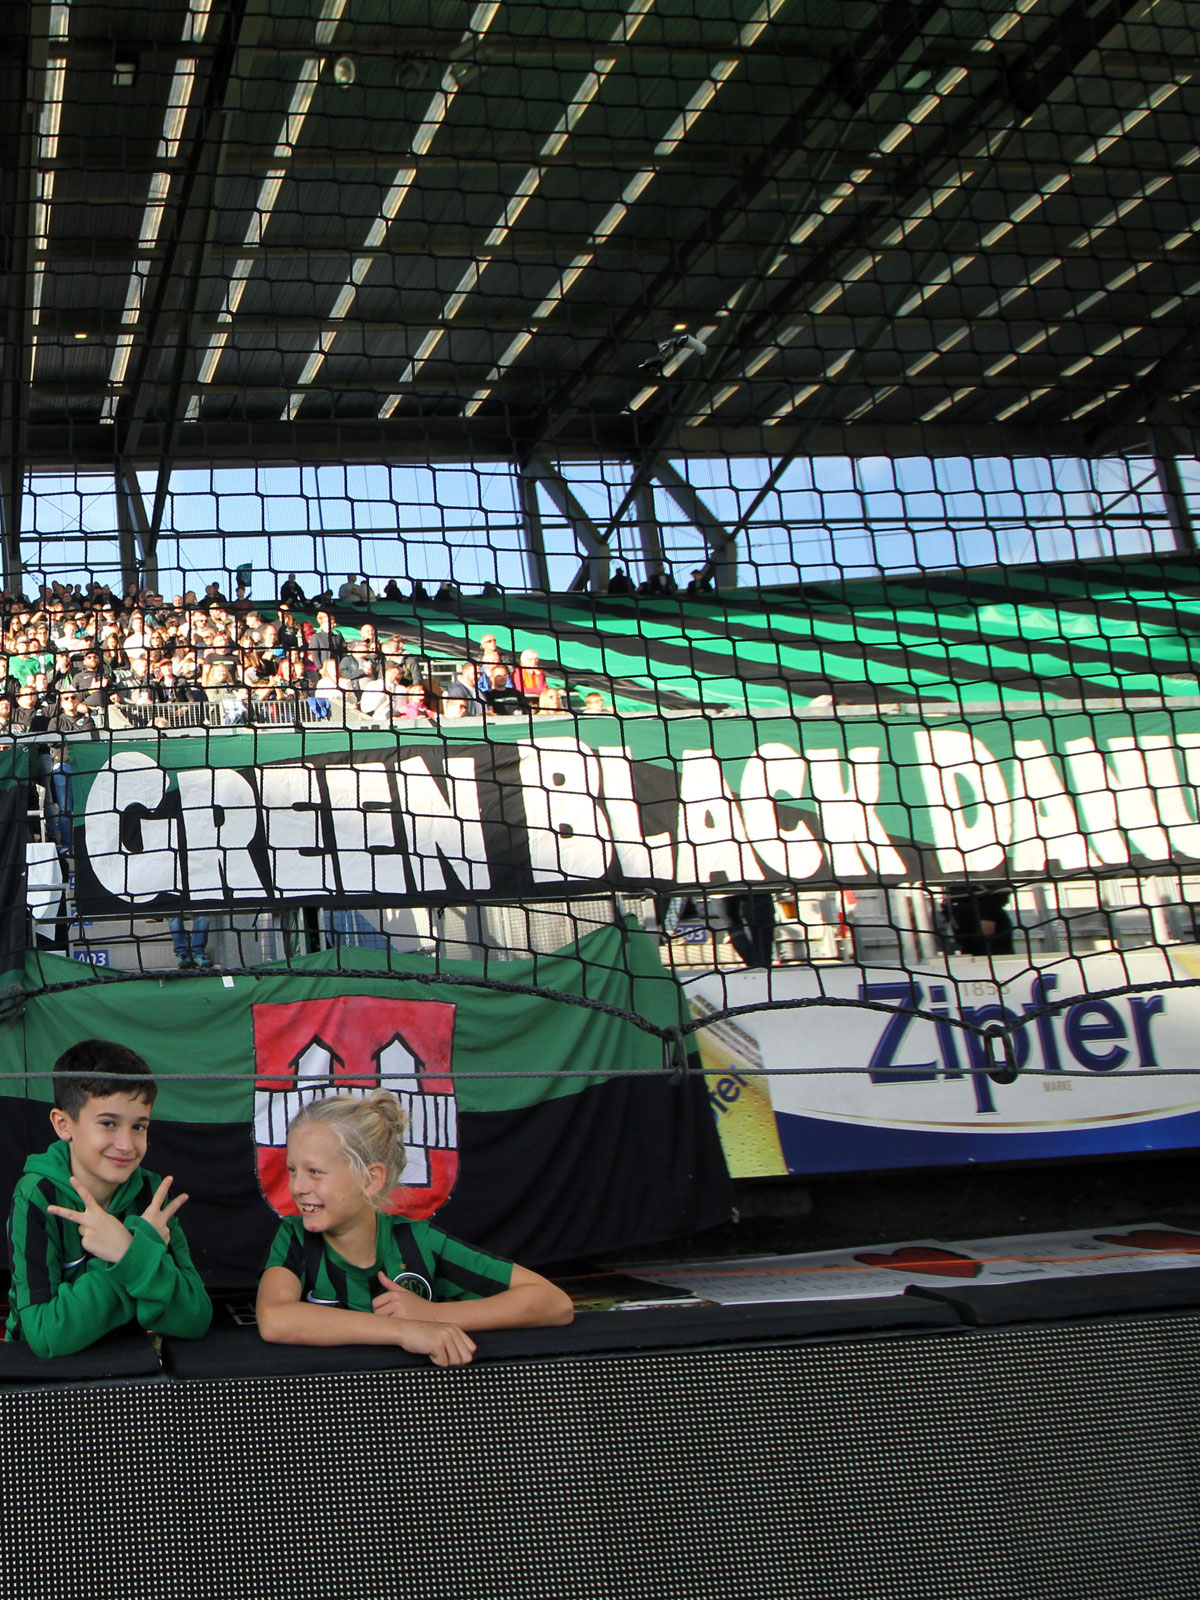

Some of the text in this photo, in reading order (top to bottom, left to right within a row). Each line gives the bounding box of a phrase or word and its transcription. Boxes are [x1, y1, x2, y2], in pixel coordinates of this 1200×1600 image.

[85, 751, 490, 903] GREEN
[517, 736, 907, 883] BLACK
[858, 973, 1166, 1114] Zipfer
